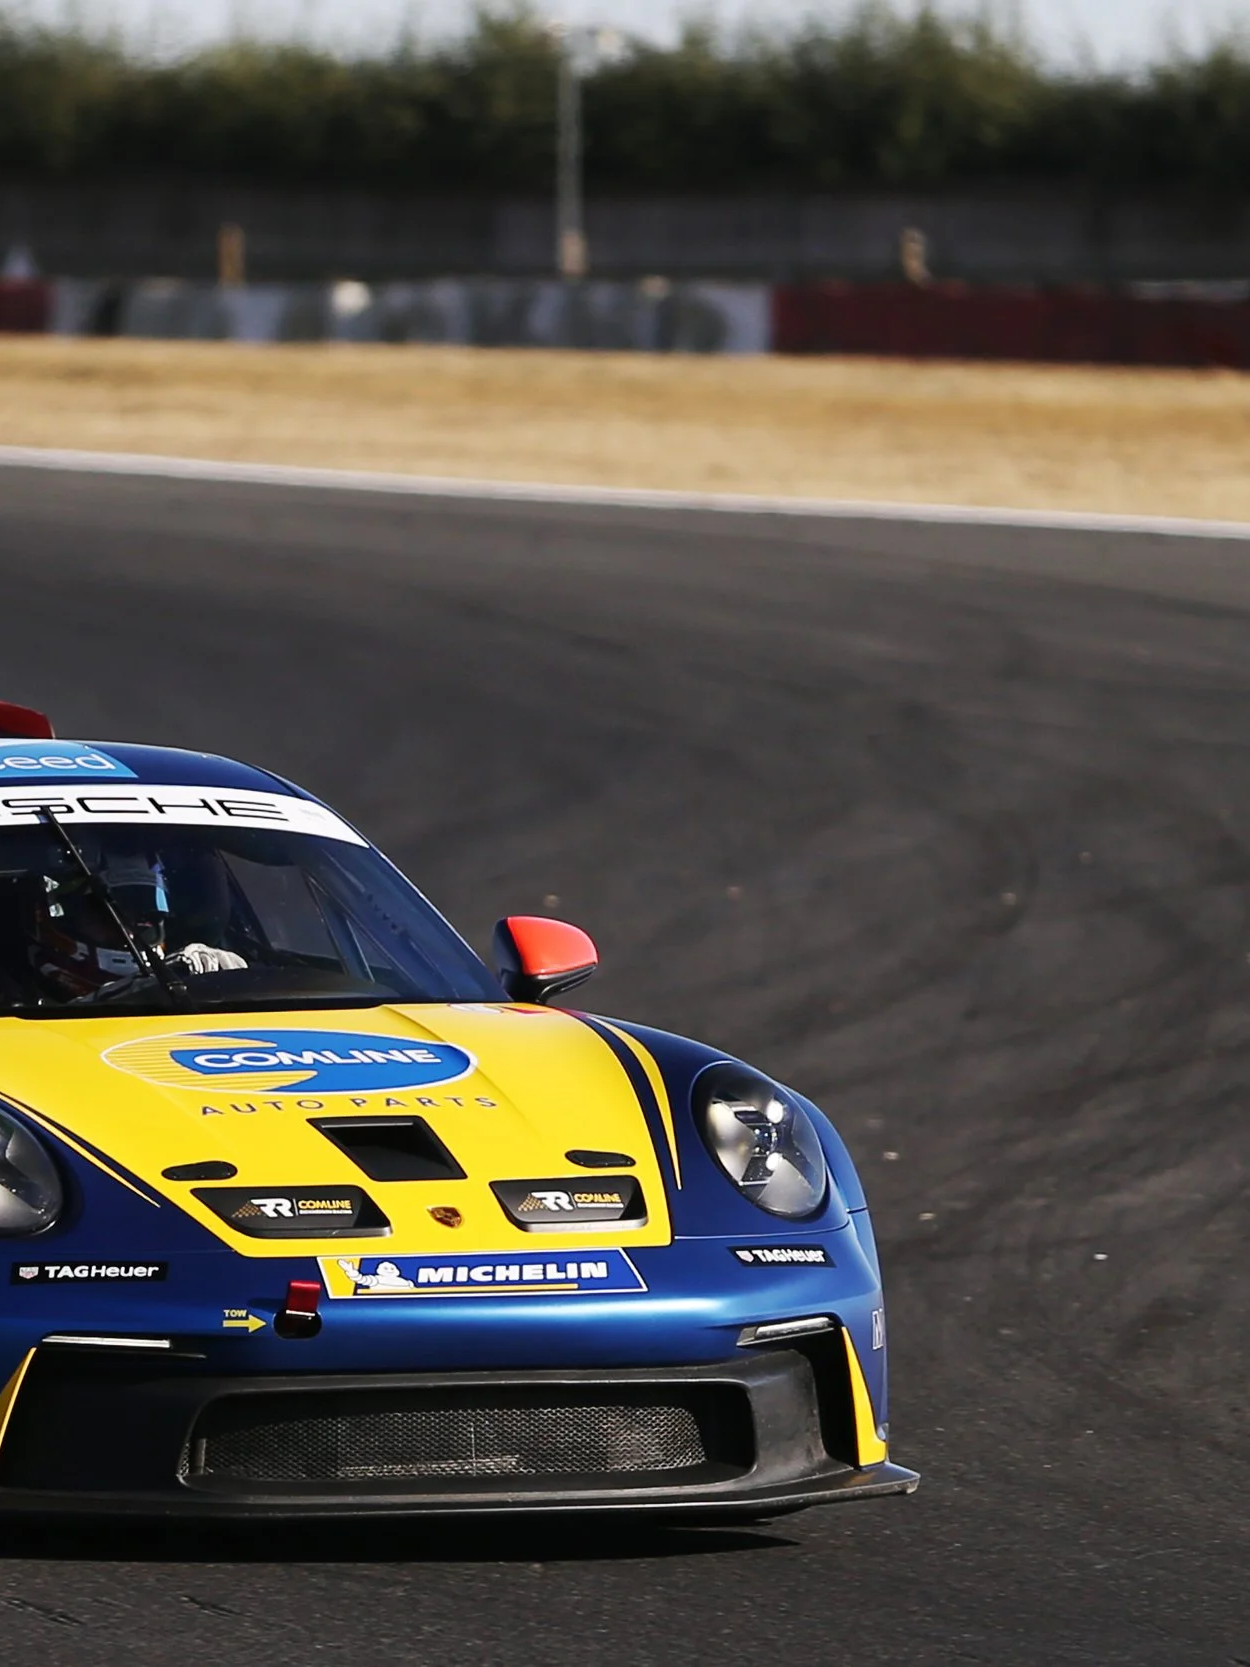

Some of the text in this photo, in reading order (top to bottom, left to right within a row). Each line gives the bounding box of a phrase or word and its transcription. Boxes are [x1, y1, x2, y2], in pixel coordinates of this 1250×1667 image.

[193, 1048, 442, 1069] COMLINE
[202, 1096, 499, 1116] AUTO PARTS
[298, 1199, 352, 1210] COMLINE
[574, 1193, 621, 1203] COMLINE
[417, 1261, 608, 1284] MICHELIN
[223, 1309, 248, 1318] TOW
